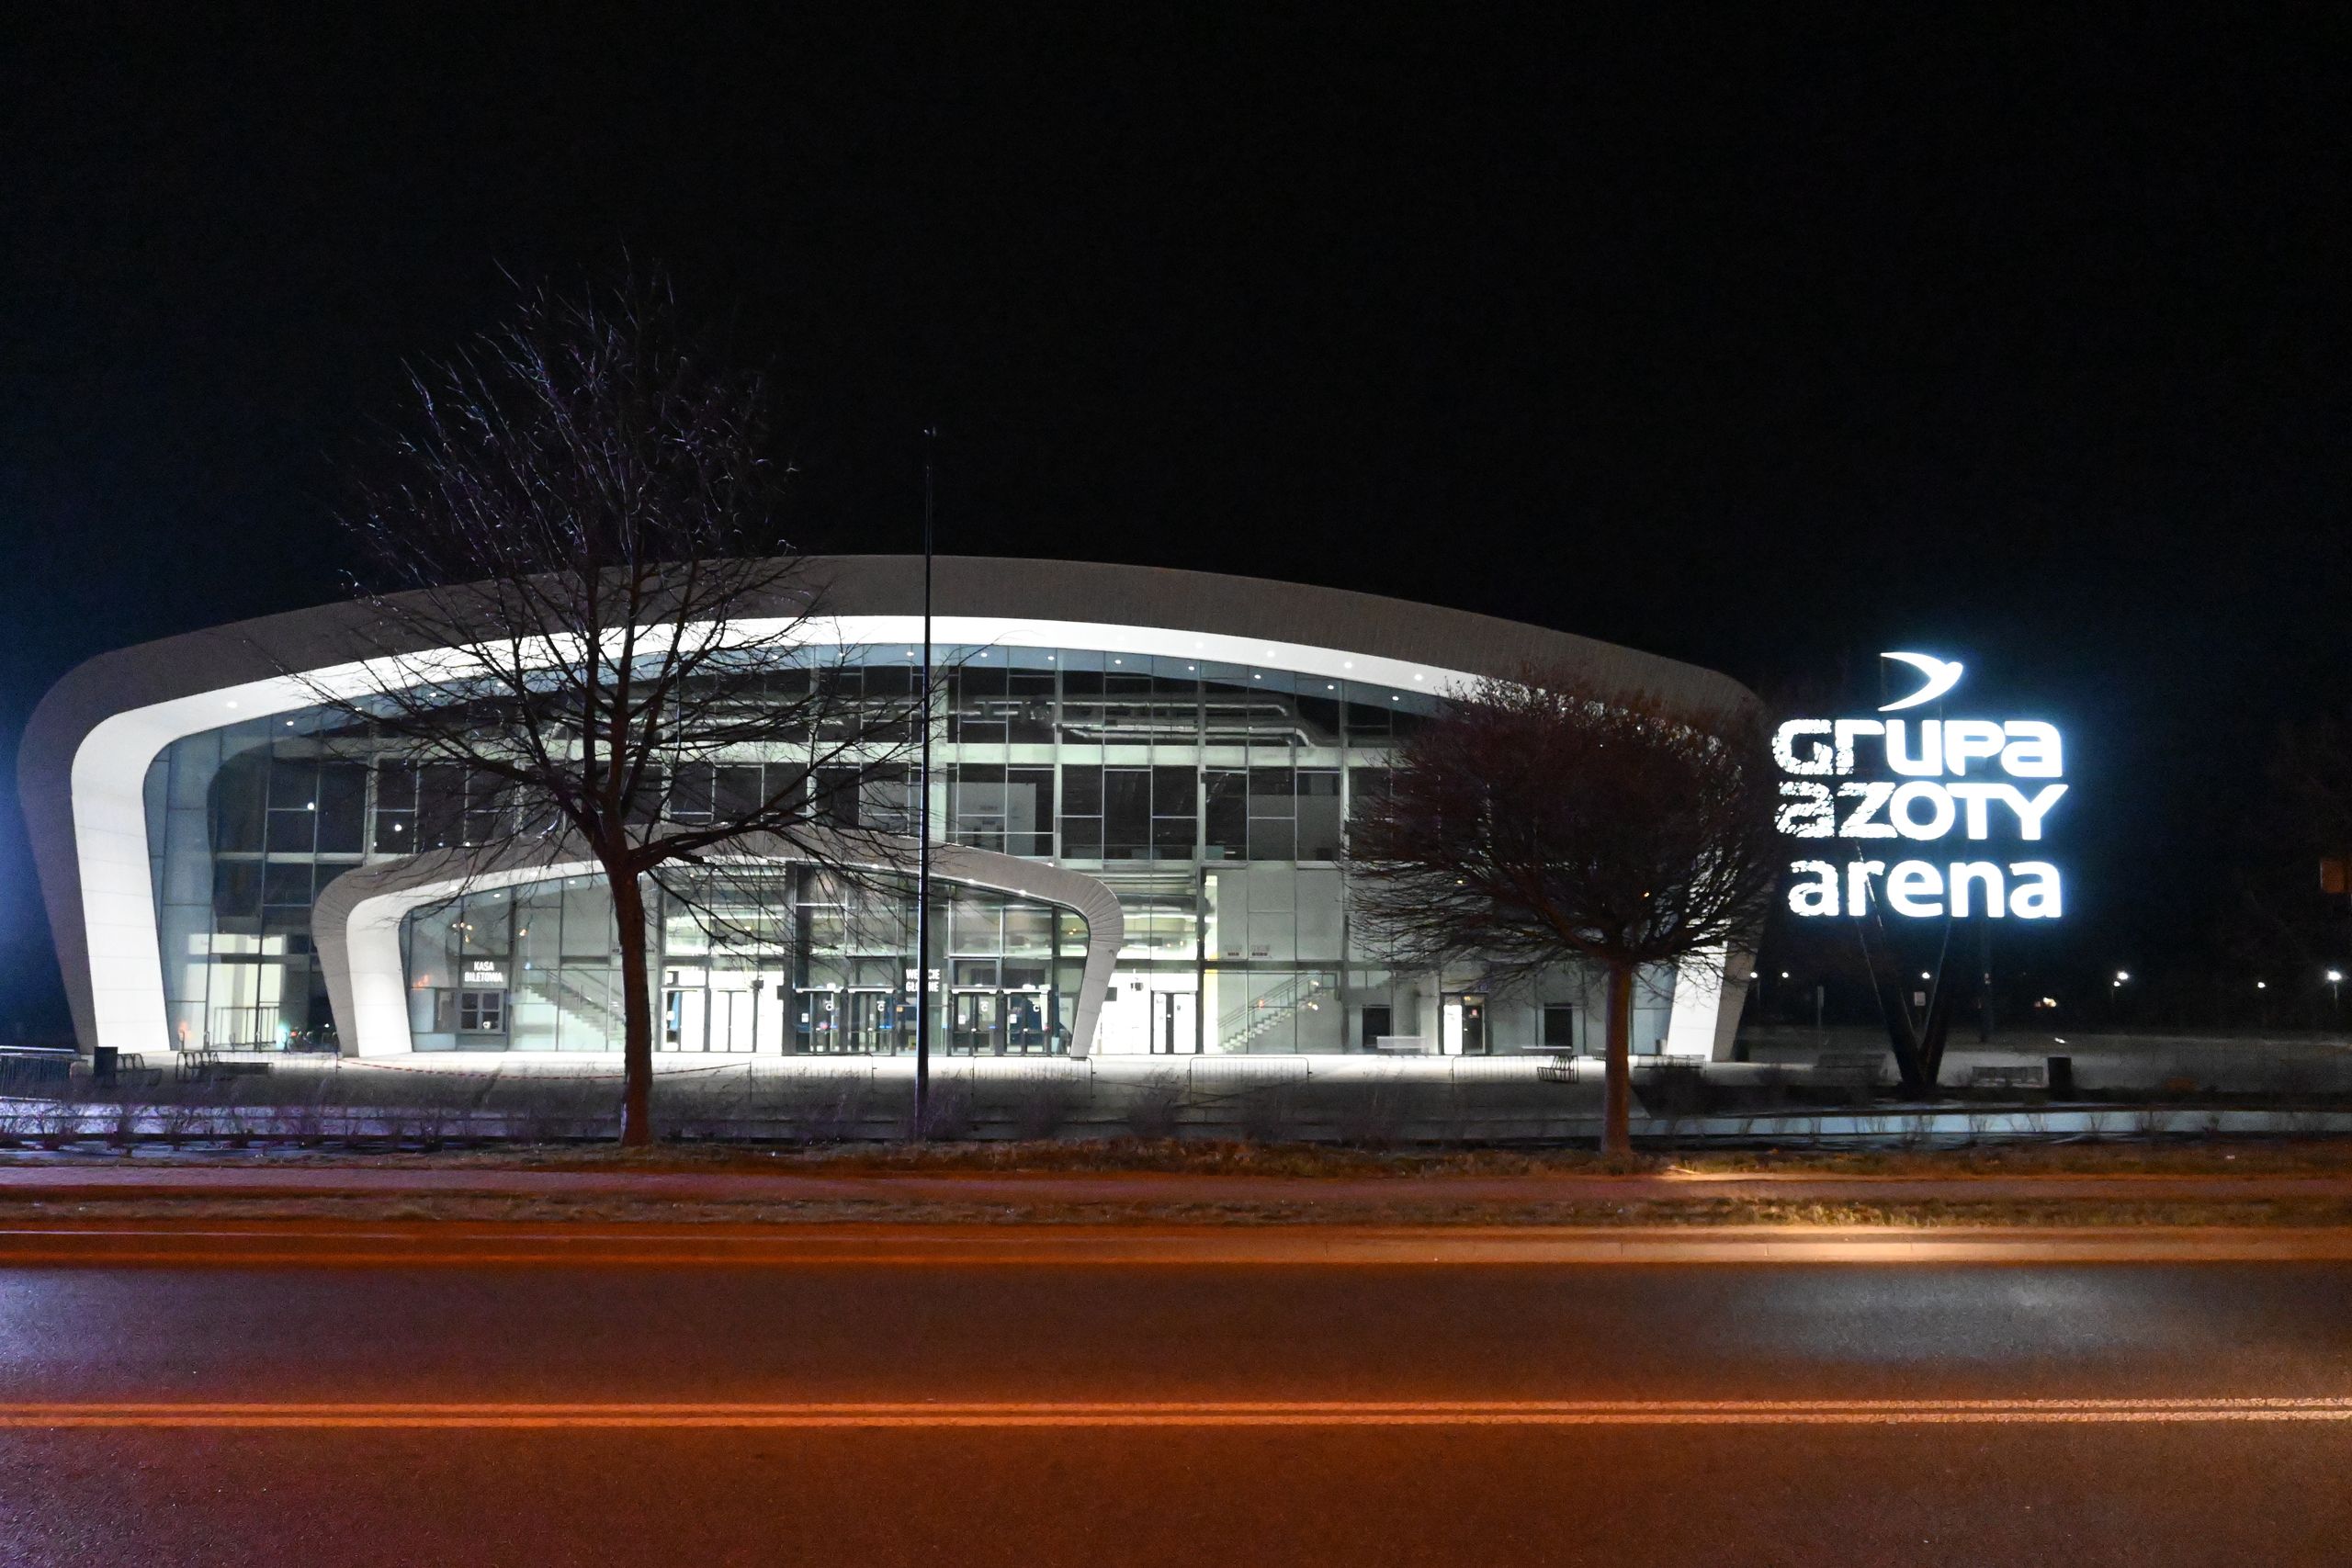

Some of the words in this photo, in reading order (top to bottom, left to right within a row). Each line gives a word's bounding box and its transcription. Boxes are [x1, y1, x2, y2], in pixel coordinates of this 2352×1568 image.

[1788, 859, 2063, 919] arena
[474, 961, 494, 971] KASA
[464, 972, 503, 982] BILETOWA
